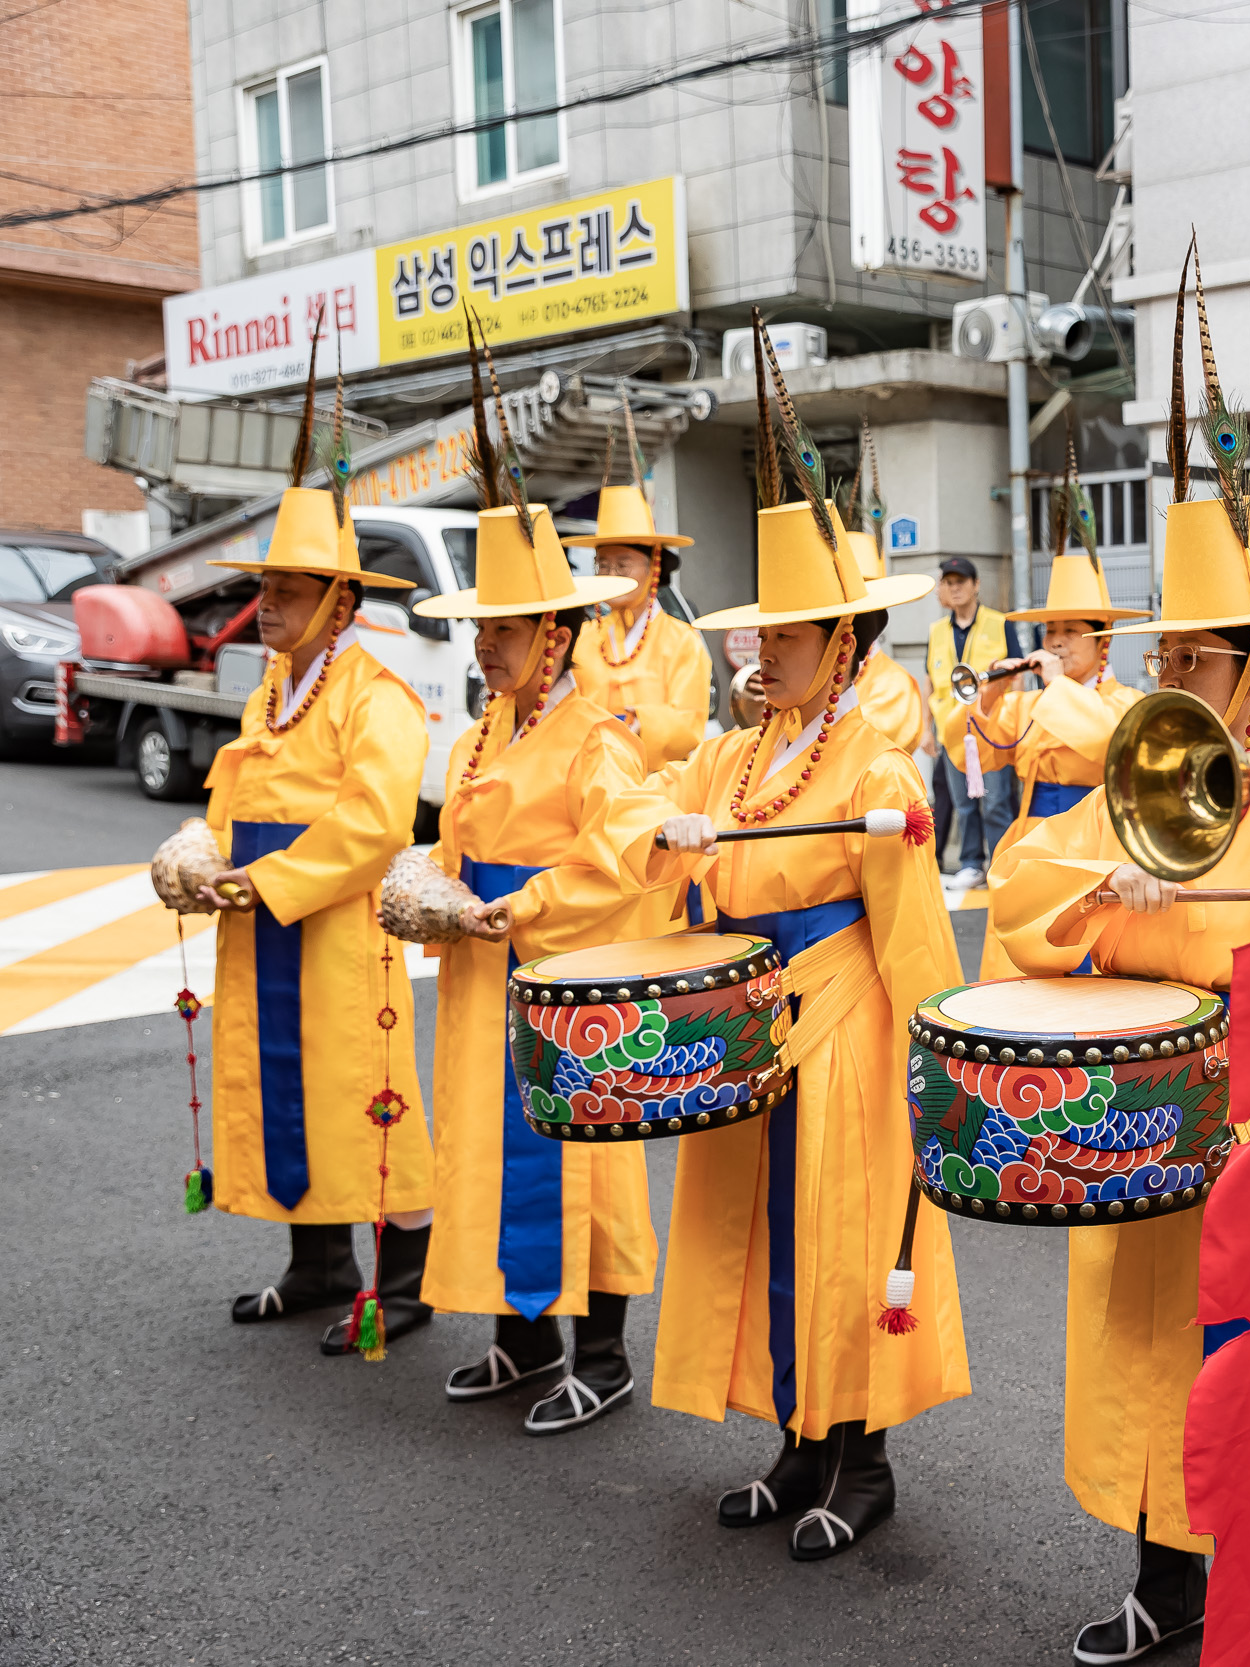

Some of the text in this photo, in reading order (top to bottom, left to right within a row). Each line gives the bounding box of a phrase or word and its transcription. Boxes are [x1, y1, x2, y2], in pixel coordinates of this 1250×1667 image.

[894, 0, 976, 234] 양탕
[393, 202, 653, 316] 삼성 익스프레스
[888, 235, 980, 271] 456-3533
[188, 296, 293, 366] Rinnai
[351, 424, 480, 505] 010-4765-222
